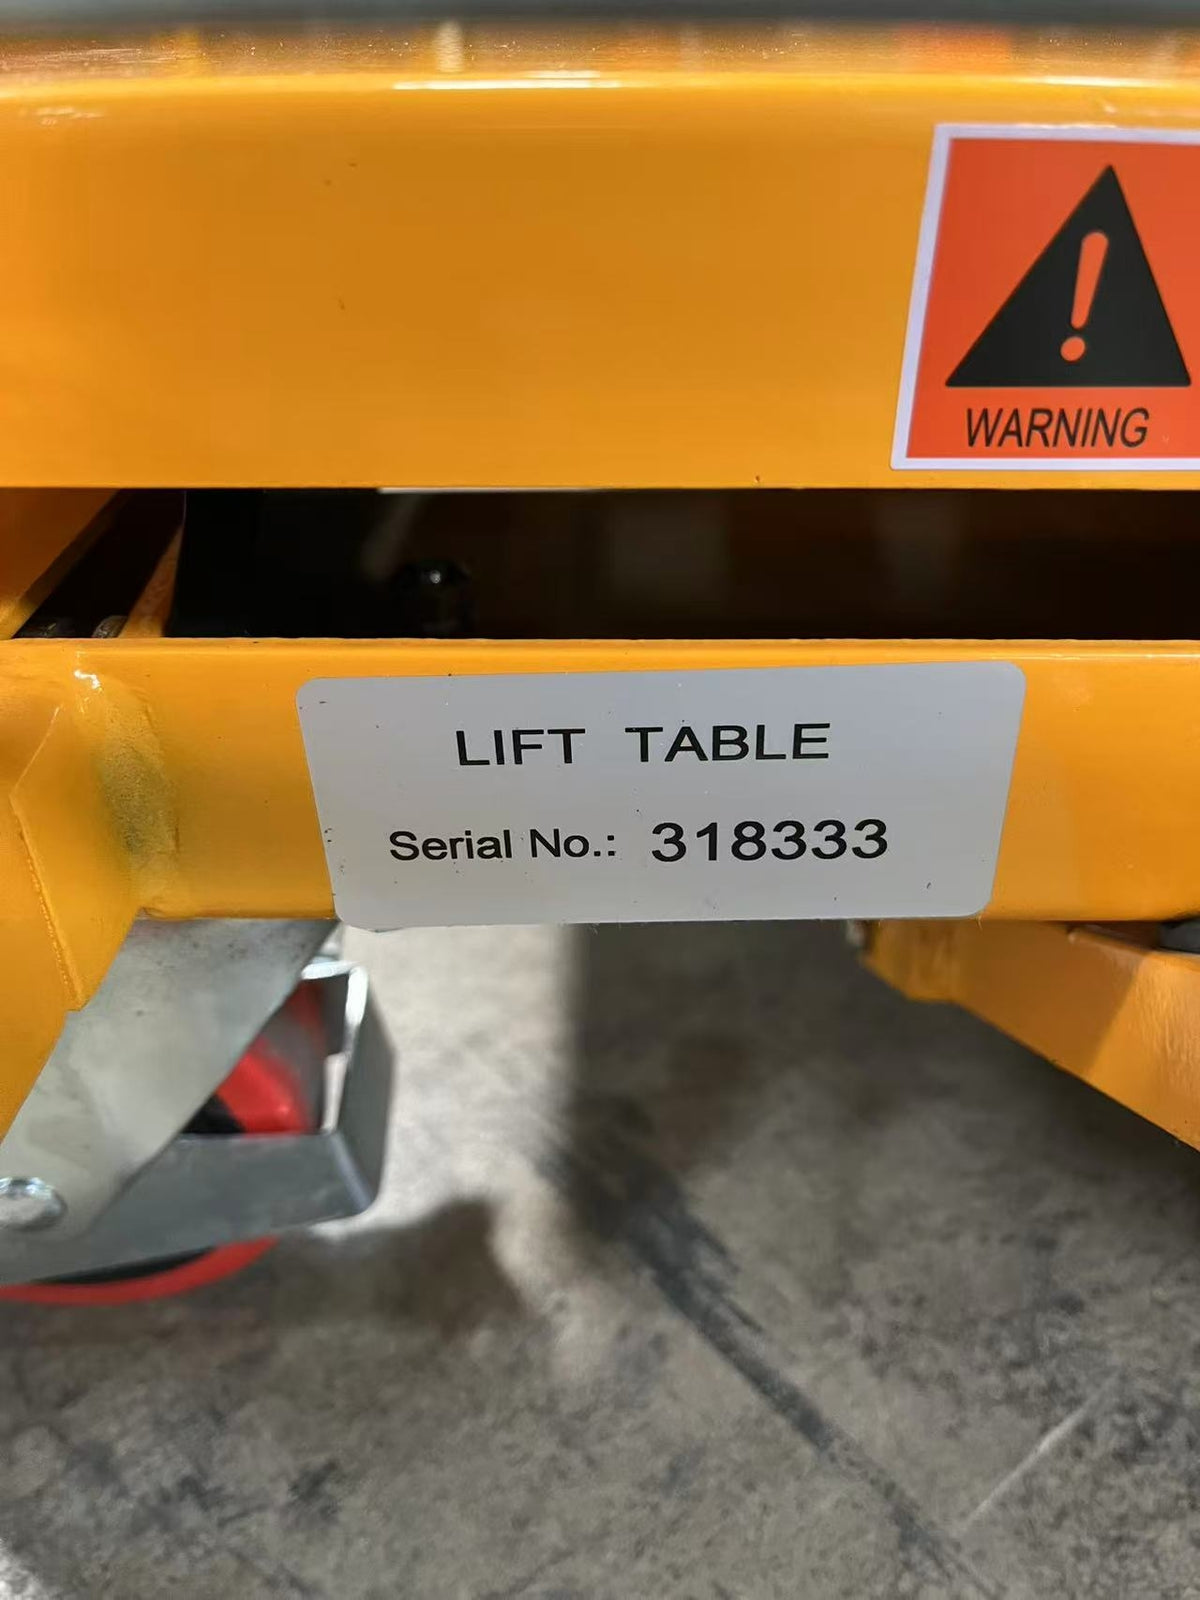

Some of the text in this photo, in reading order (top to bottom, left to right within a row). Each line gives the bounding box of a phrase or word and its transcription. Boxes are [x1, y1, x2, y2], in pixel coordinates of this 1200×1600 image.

[966, 407, 1150, 448] WARNING
[455, 722, 831, 766] LIFT TABLE
[389, 818, 888, 863] Serial No.: 318333
